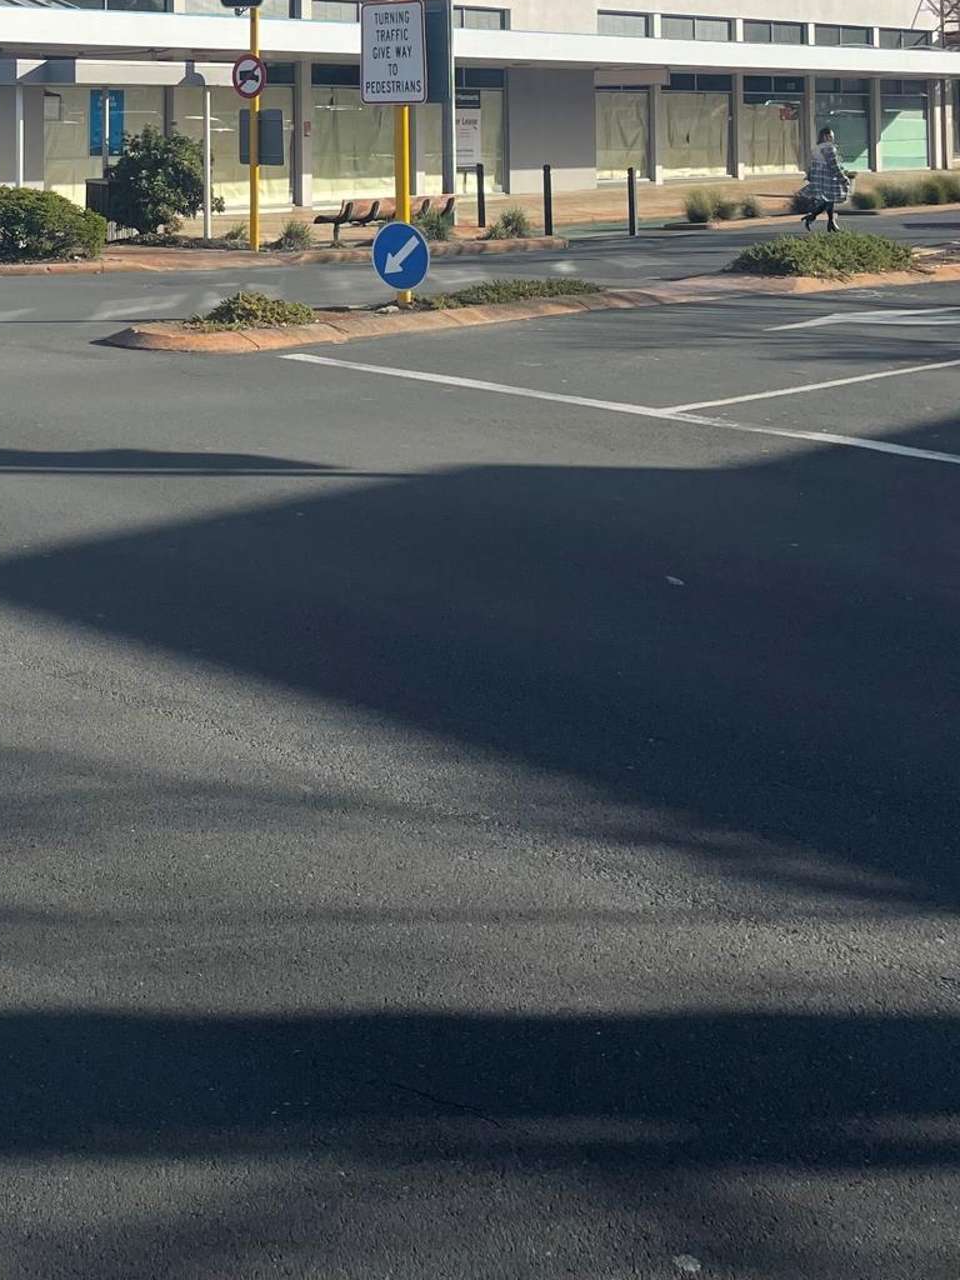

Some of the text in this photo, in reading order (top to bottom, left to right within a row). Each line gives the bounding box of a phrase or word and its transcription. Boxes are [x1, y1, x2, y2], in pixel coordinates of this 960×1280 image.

[374, 10, 410, 25] TURNING
[376, 28, 408, 41] TRAFFIC
[372, 45, 413, 59] GIVE WAY
[388, 63, 398, 76] TO
[365, 80, 422, 94] PEDESTRIANS
